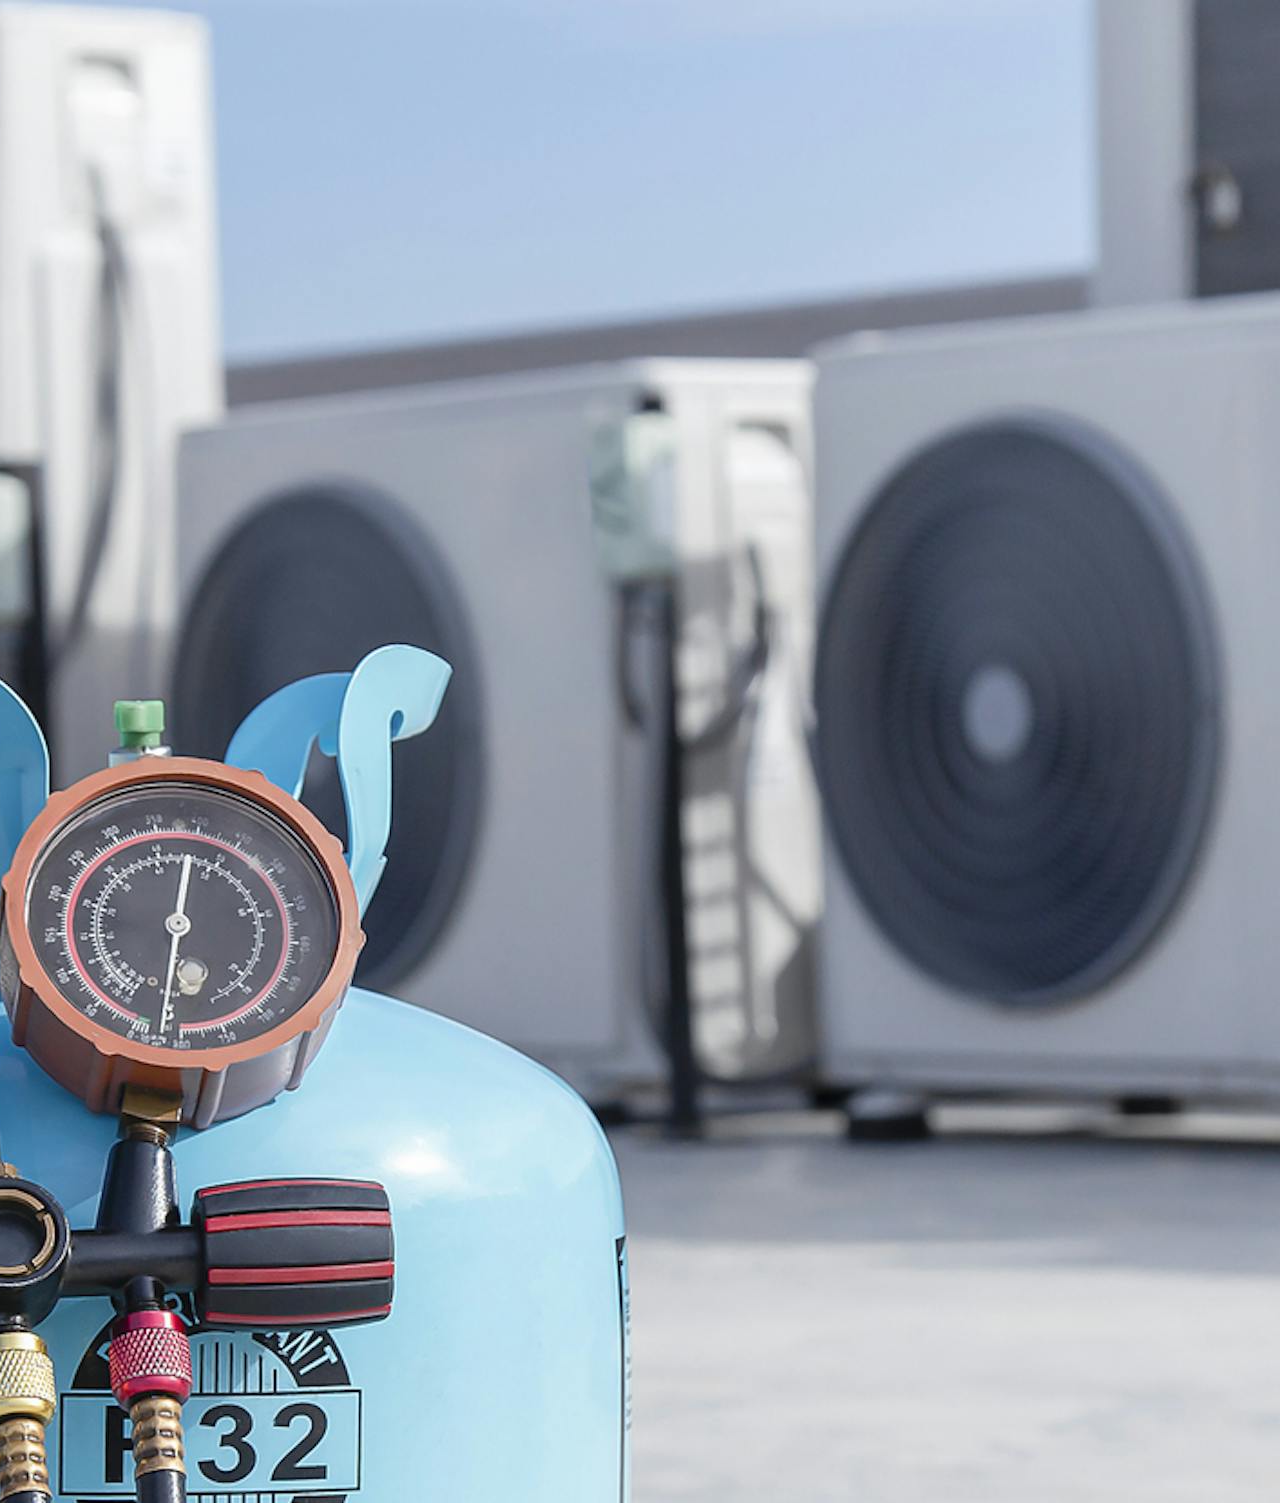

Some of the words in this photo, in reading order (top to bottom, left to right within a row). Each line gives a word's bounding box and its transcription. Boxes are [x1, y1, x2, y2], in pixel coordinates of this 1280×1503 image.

[48, 884, 62, 901] 200
[44, 926, 57, 943] 150
[55, 967, 70, 984] 100
[84, 1003, 97, 1017] 50
